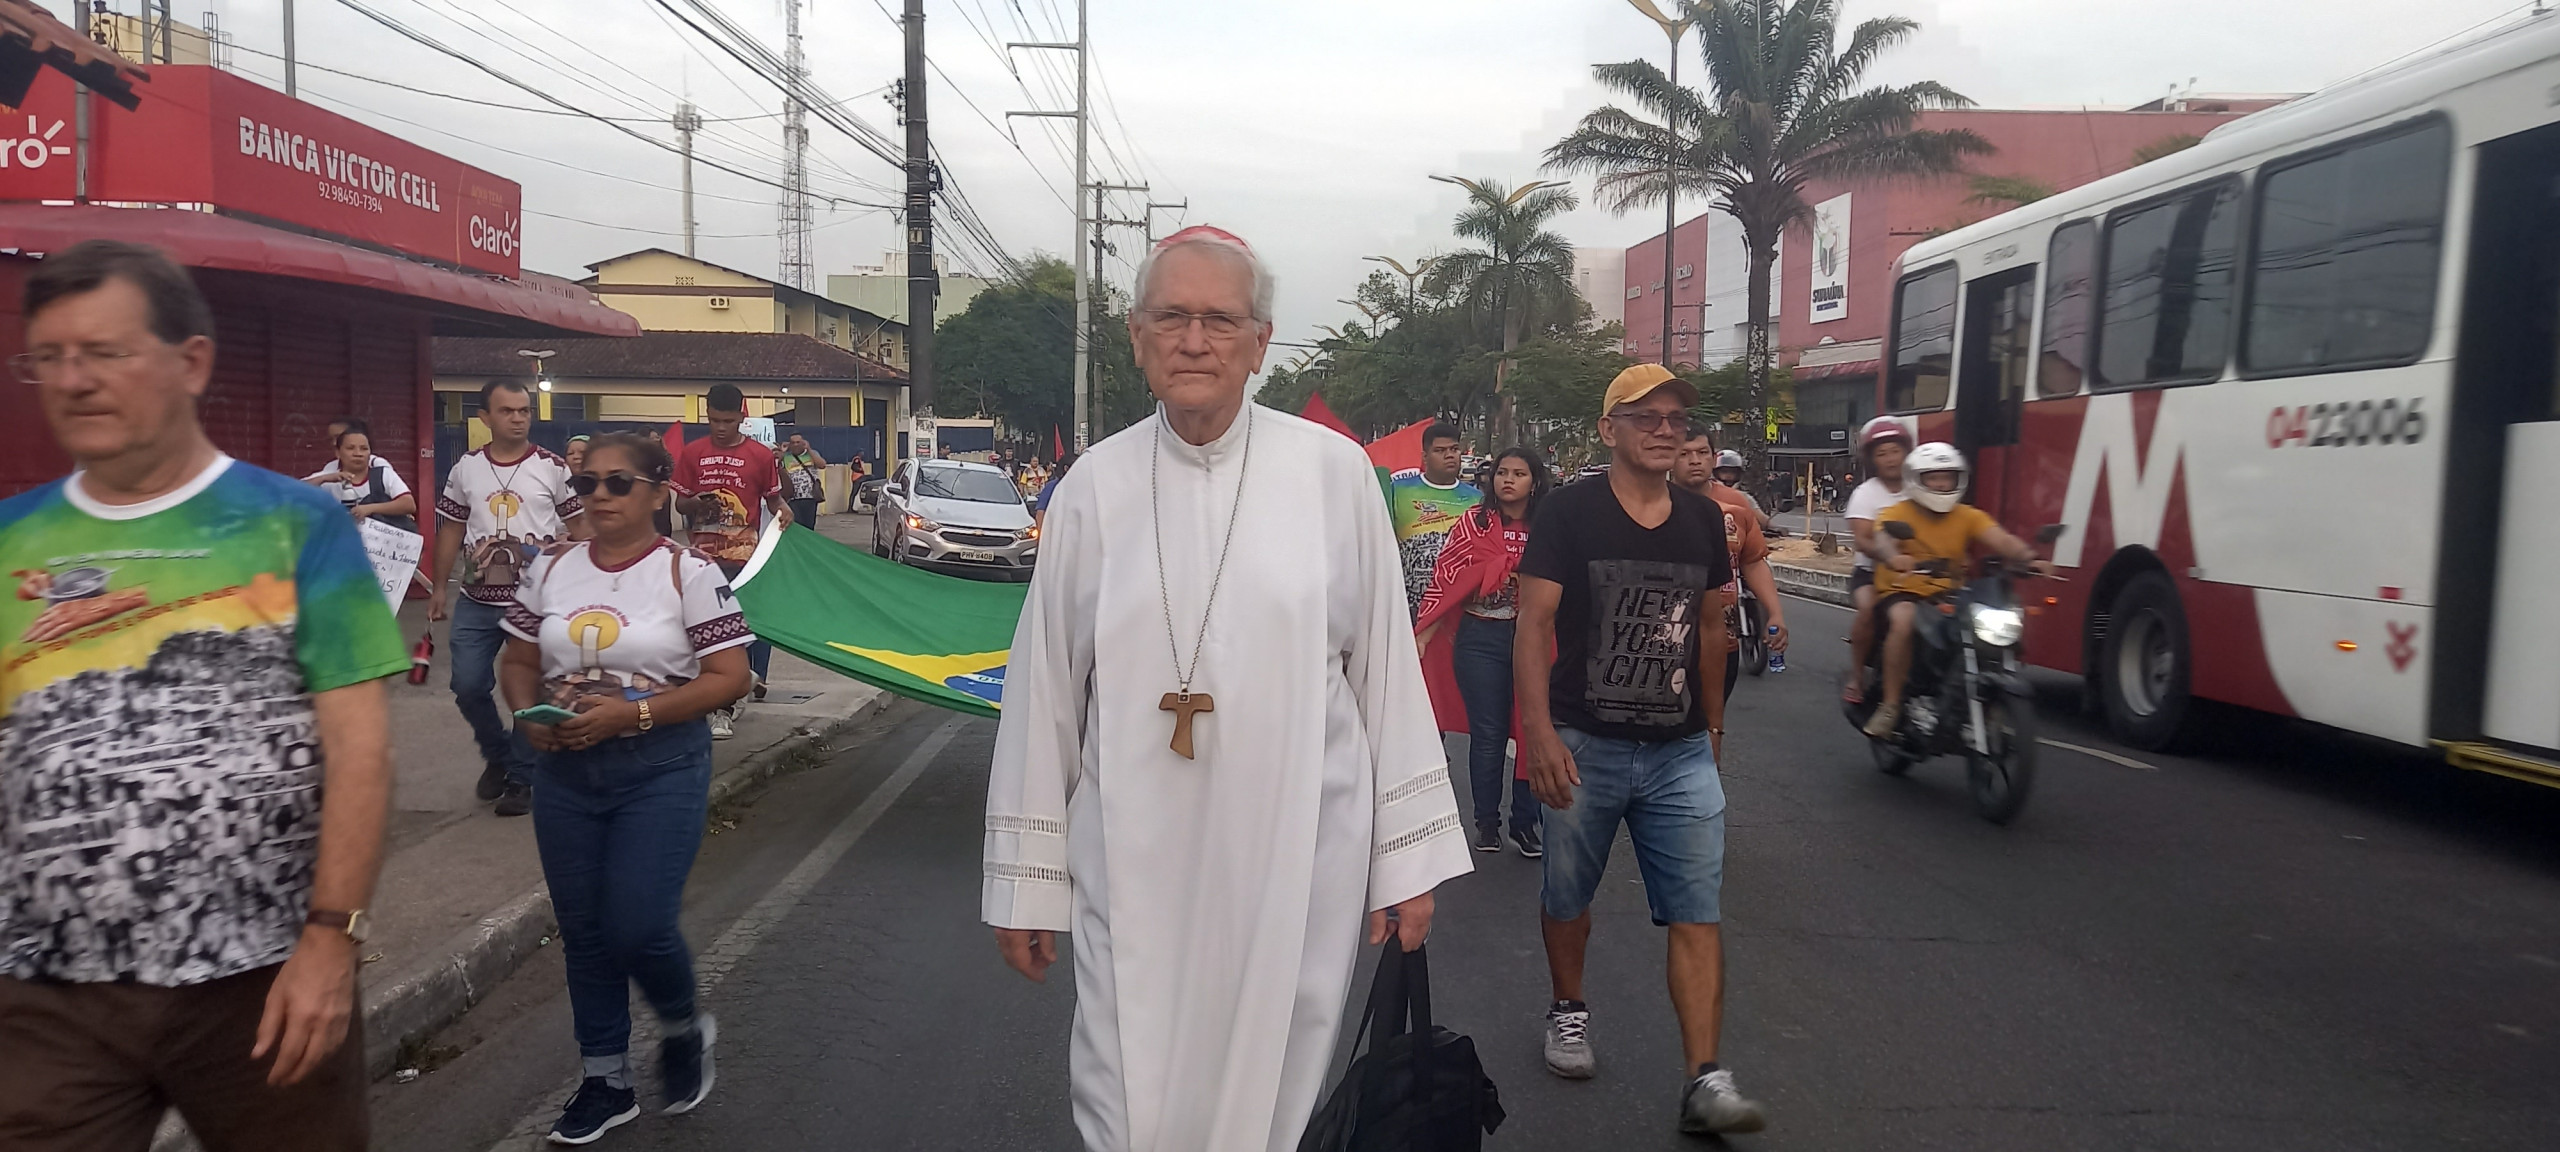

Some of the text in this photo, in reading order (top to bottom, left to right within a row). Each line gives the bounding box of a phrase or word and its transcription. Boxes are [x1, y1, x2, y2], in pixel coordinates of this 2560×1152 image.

[0, 138, 48, 168] ro
[239, 116, 321, 176] BANCA
[324, 144, 398, 200] VICTOR
[318, 182, 383, 214] 92 98450-7394
[470, 211, 514, 258] Claro
[2266, 396, 2428, 450] 0423006
[1503, 531, 1529, 542] PO JU
[1602, 654, 1676, 690] CITY
